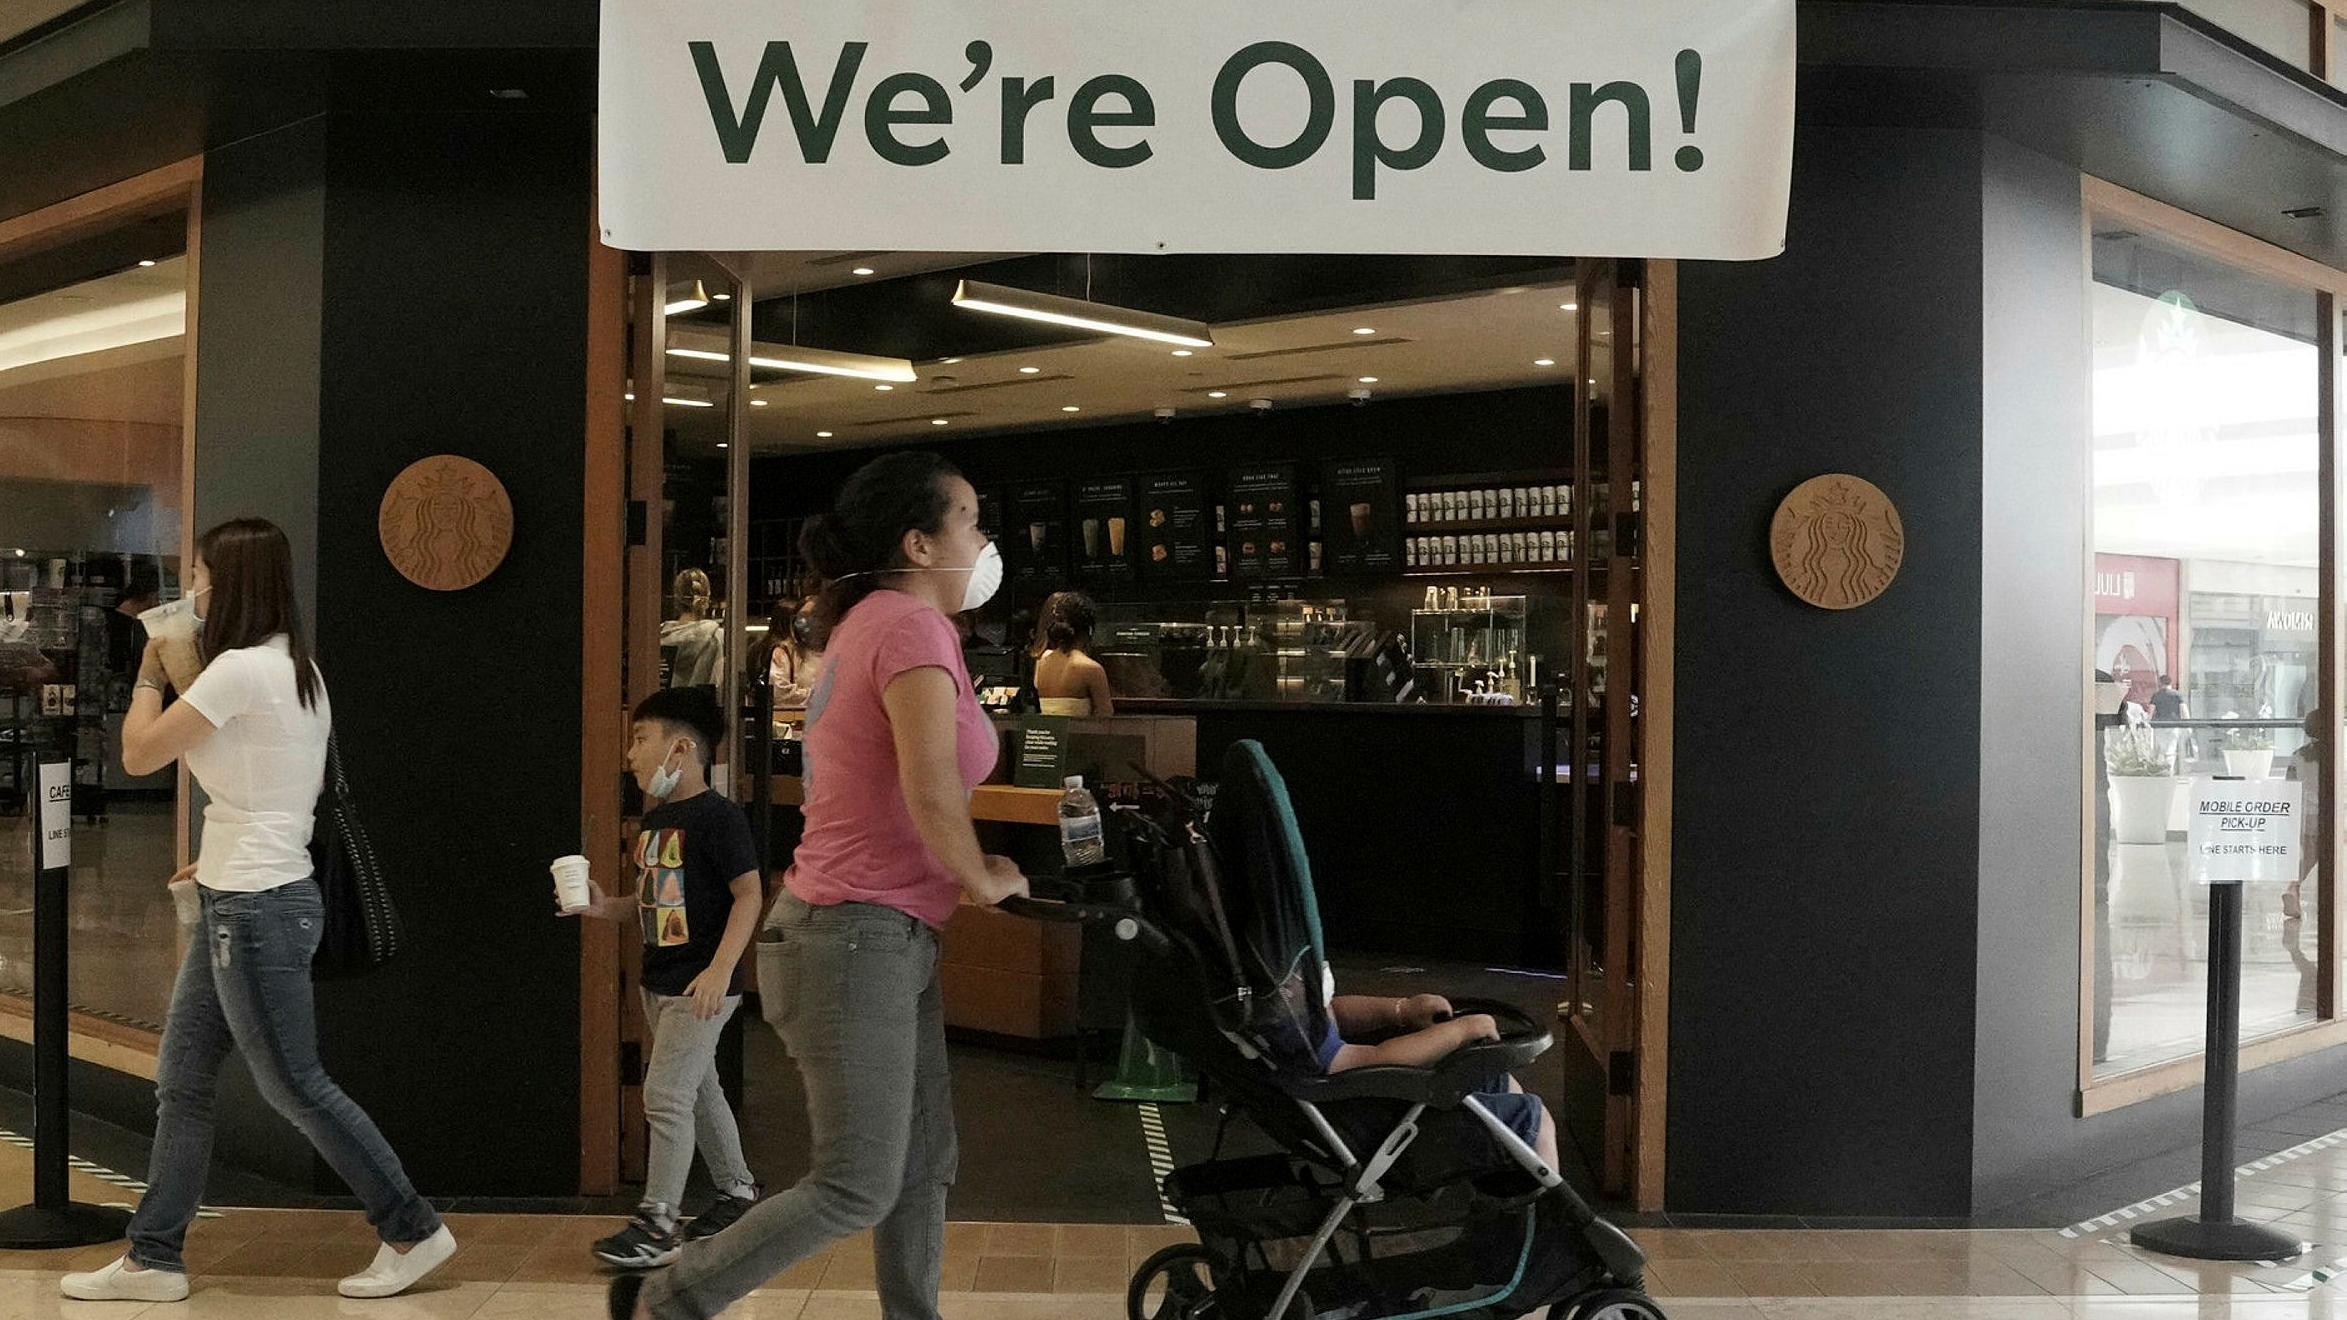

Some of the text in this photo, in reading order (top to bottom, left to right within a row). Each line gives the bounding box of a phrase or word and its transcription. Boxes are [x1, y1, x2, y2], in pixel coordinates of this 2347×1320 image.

[688, 40, 1703, 200] We’re Open!
[2199, 801, 2291, 814] MOBILE ORDER
[2221, 817, 2267, 829] PICK-UP
[48, 829, 63, 840] LINE
[2200, 844, 2289, 855] LNE STARTS HERE
